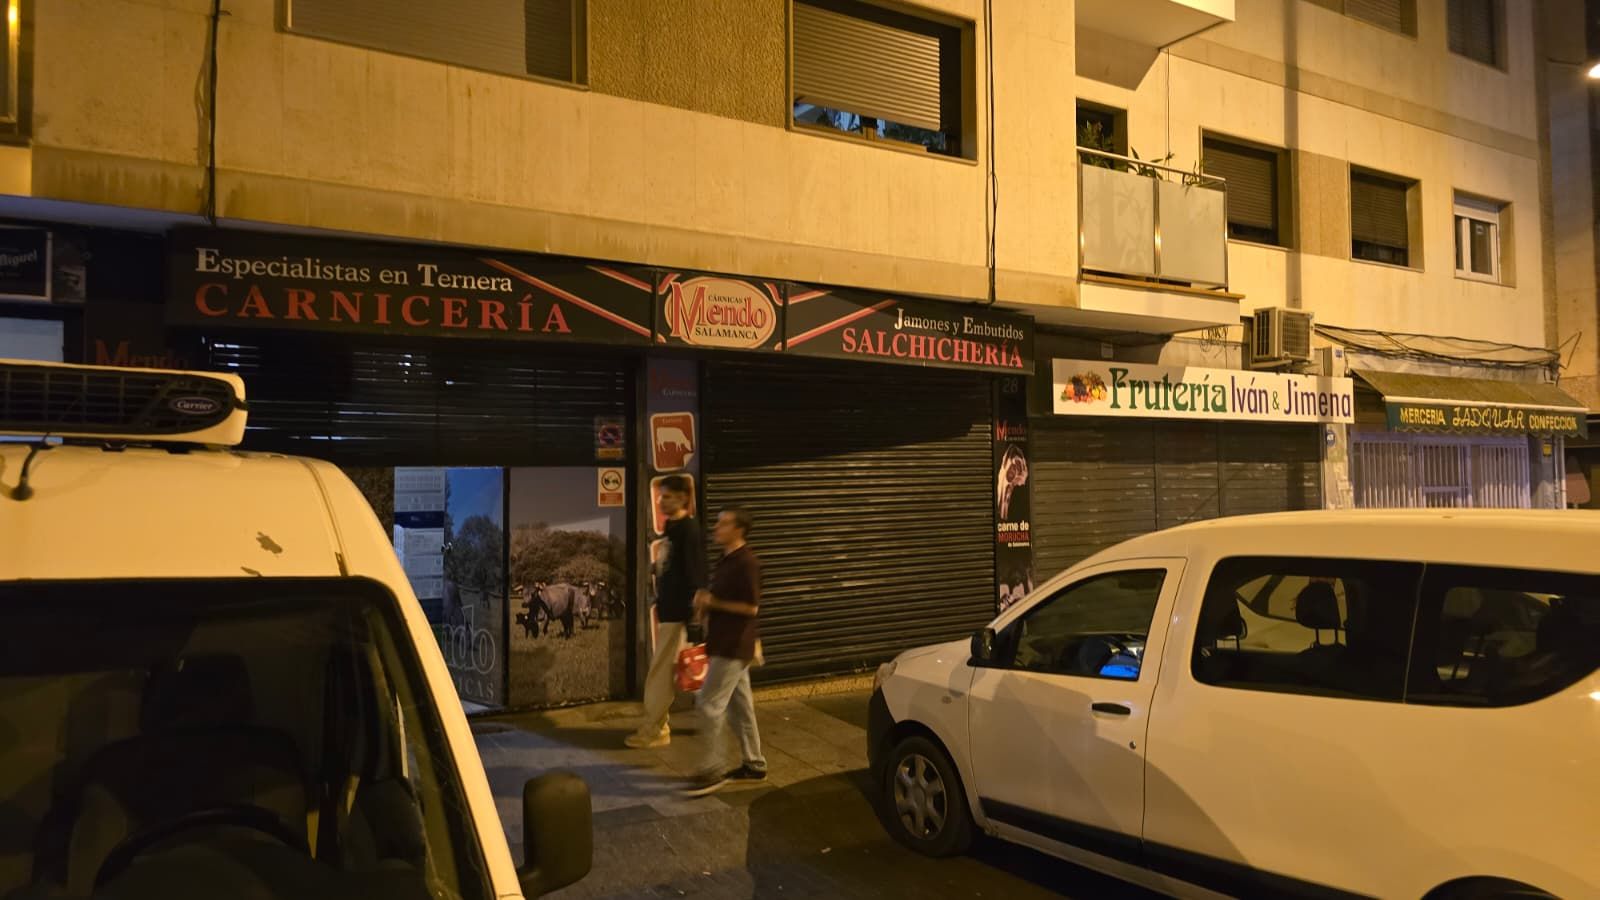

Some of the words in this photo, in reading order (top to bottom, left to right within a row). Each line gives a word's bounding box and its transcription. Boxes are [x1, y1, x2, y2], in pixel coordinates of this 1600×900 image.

[195, 247, 371, 283] Especialistas
[379, 268, 409, 285] en
[417, 263, 513, 292] Ternera
[195, 283, 572, 333] CARNICERÍA
[670, 281, 767, 340] Mendo
[894, 308, 950, 332] Jamones
[952, 321, 961, 336] y
[963, 316, 1024, 341] Embutidos
[695, 327, 759, 340] SALAMANCA
[841, 327, 1024, 369] SALCHICHERÍA
[176, 400, 214, 411] Carrier
[1109, 367, 1228, 413] Frutería
[1231, 374, 1270, 415] Iván
[1272, 390, 1281, 411] &
[1283, 378, 1352, 418] Jimena
[1399, 407, 1447, 426] MERCERIA
[1529, 414, 1578, 431] CONFECCION
